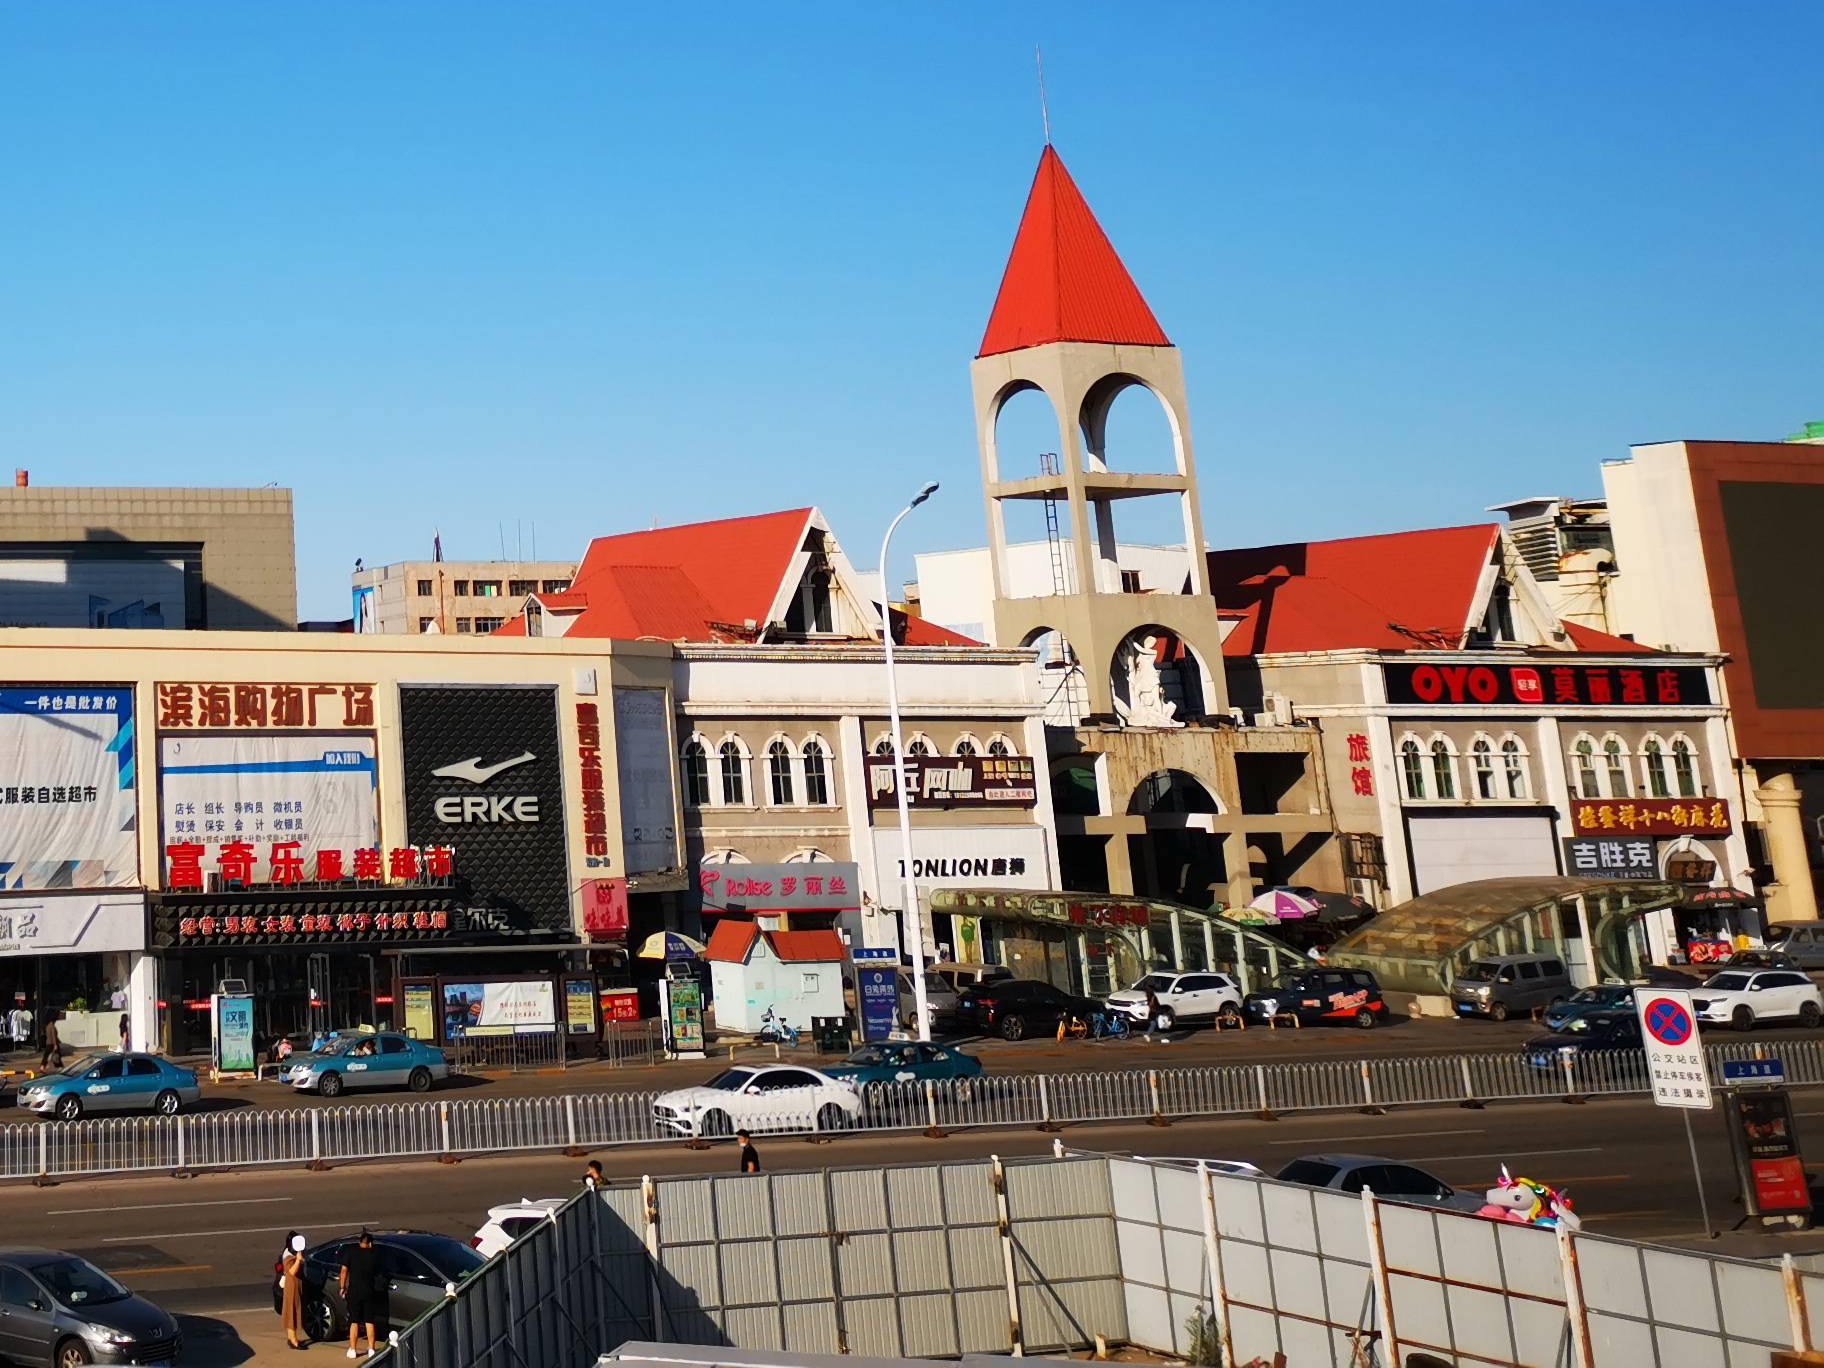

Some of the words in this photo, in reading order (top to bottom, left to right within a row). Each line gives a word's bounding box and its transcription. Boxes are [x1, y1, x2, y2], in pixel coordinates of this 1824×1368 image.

[1411, 665, 1499, 702] OYO
[24, 695, 118, 711] 一件也是批发价
[159, 684, 375, 727] 滨海购物广场
[175, 802, 196, 815] 店长
[204, 802, 225, 815] 组长
[234, 801, 264, 815] 导购员
[273, 801, 304, 814] 微机员
[433, 795, 540, 824] ERKE
[204, 819, 225, 832] 保安
[273, 818, 304, 831] 收银员
[1573, 842, 1653, 869] 吉胜克
[898, 858, 988, 878] TONLION
[780, 876, 848, 896] 罗丽丝
[263, 915, 296, 933] 女装
[300, 914, 333, 932] 童装
[375, 911, 408, 931] 针织
[1651, 1052, 1699, 1064] 公交站区
